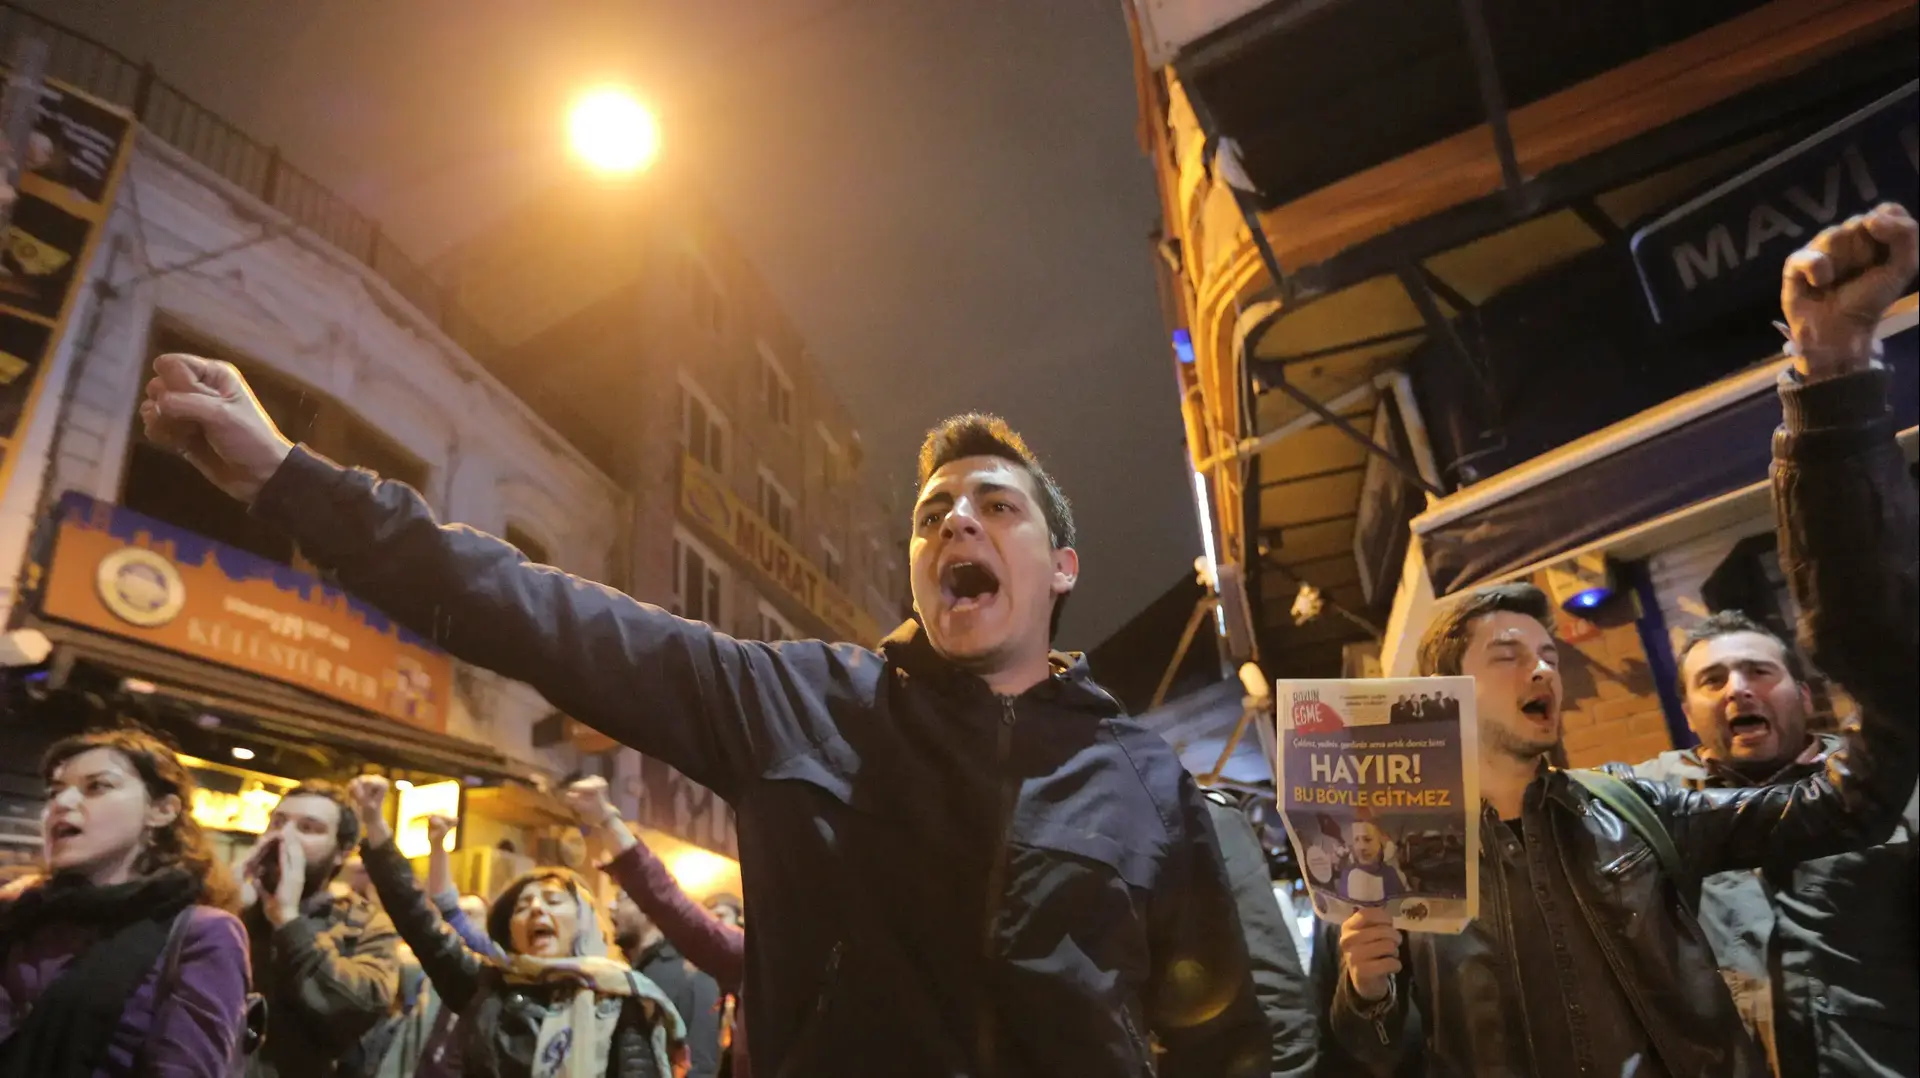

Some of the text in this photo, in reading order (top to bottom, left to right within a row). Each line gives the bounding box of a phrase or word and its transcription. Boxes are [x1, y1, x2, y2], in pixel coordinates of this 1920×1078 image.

[736, 509, 818, 614] MURAT
[1310, 753, 1422, 785] HAYIR!
[1293, 784, 1452, 807] BU BÖYLE GİTMEZ
